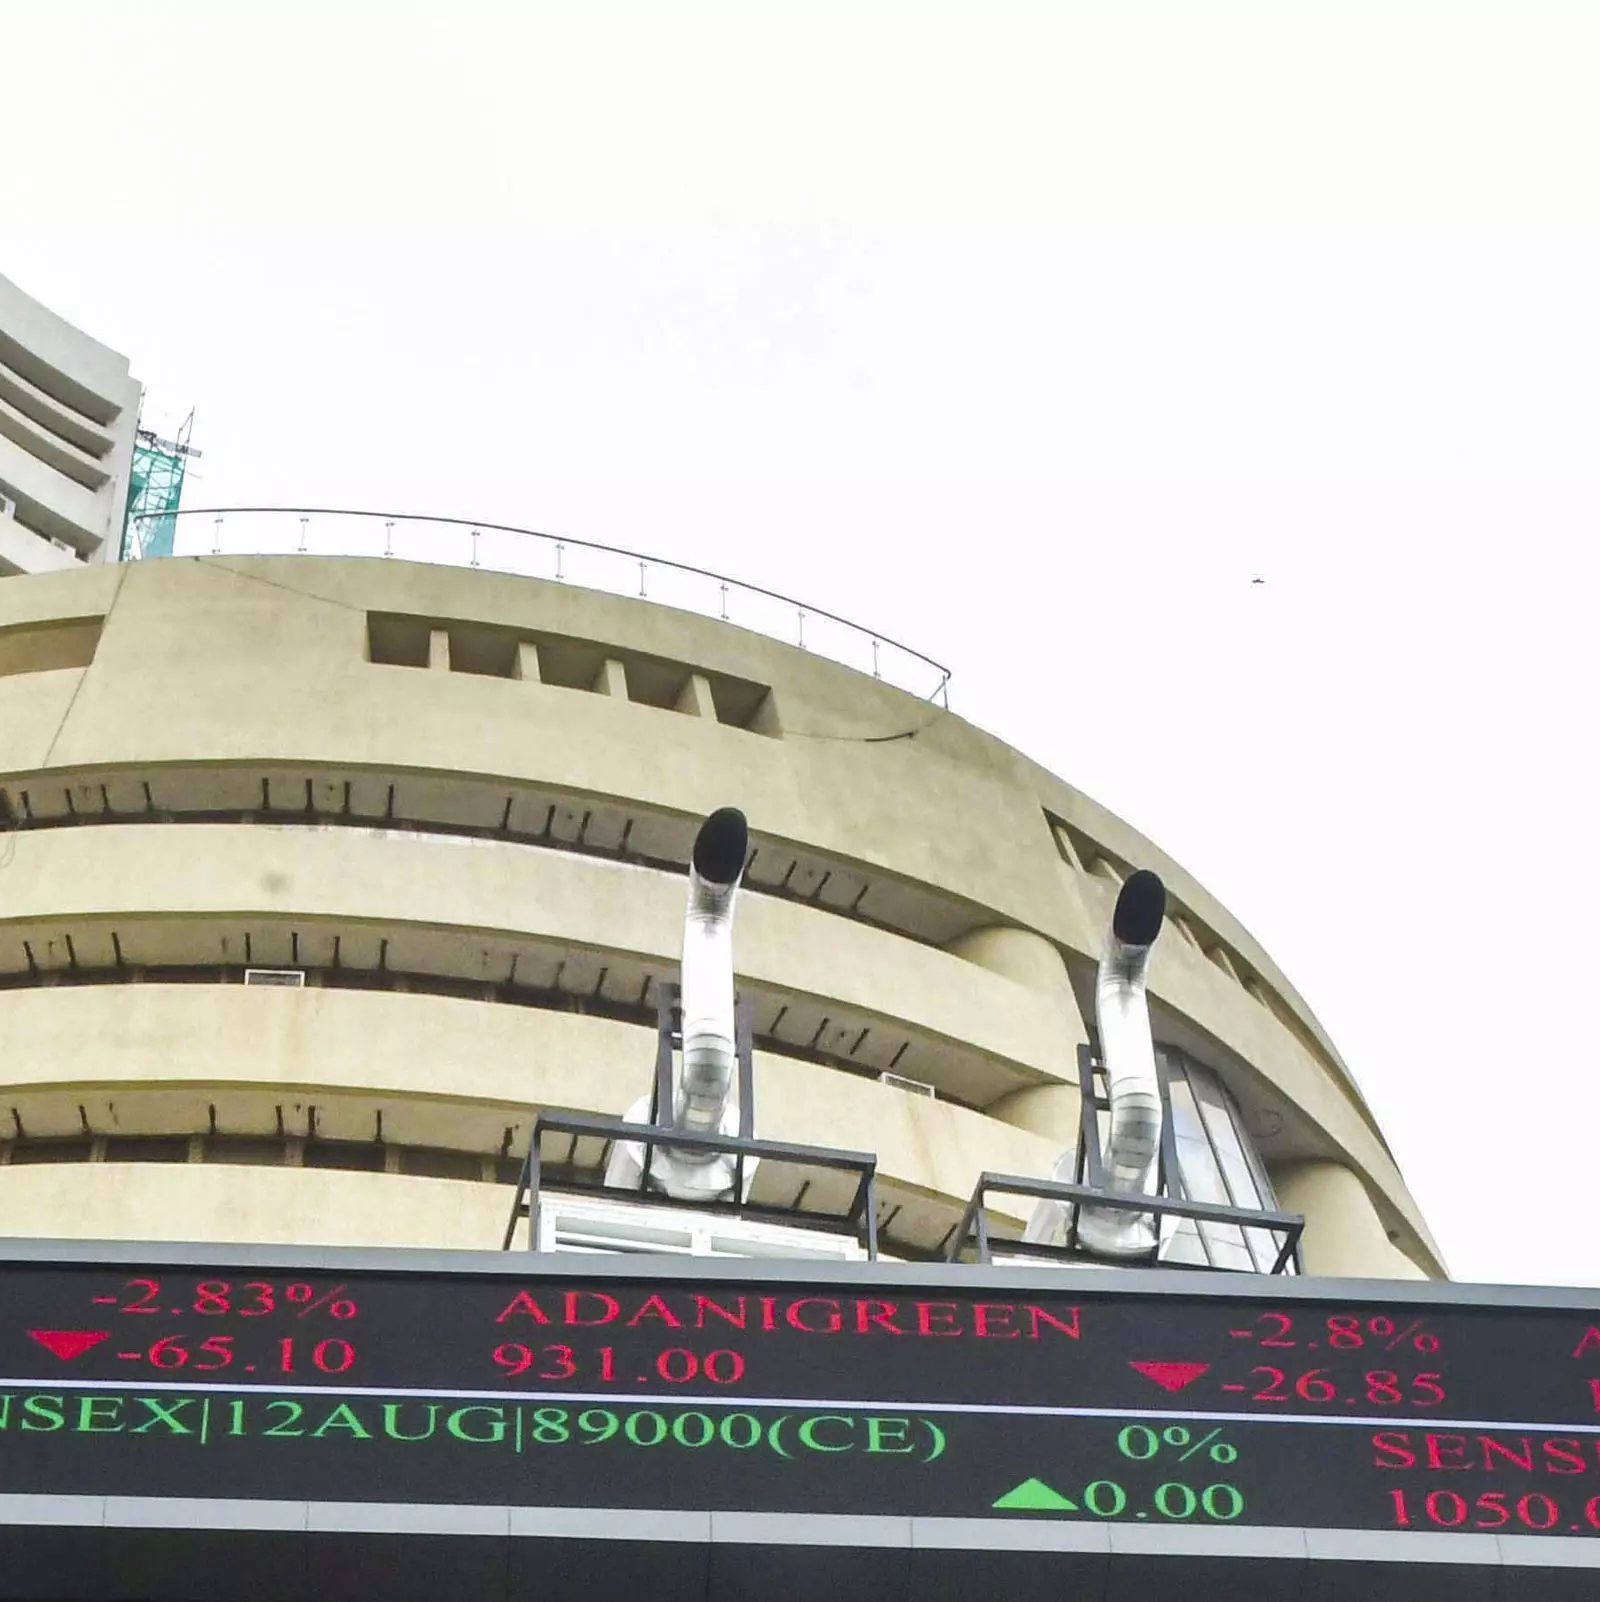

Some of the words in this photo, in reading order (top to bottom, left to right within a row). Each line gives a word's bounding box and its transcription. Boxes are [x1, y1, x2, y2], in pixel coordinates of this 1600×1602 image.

[92, 1278, 358, 1320] -2.83%
[496, 1289, 1082, 1340] ADANIGREEN
[117, 1334, 357, 1374] -65.10
[1229, 1312, 1441, 1355] -2.8%
[493, 1343, 745, 1384] 931.00
[1220, 1366, 1447, 1406] -26.85
[1116, 1424, 1239, 1464] 0%
[1083, 1479, 1244, 1520] 0.00
